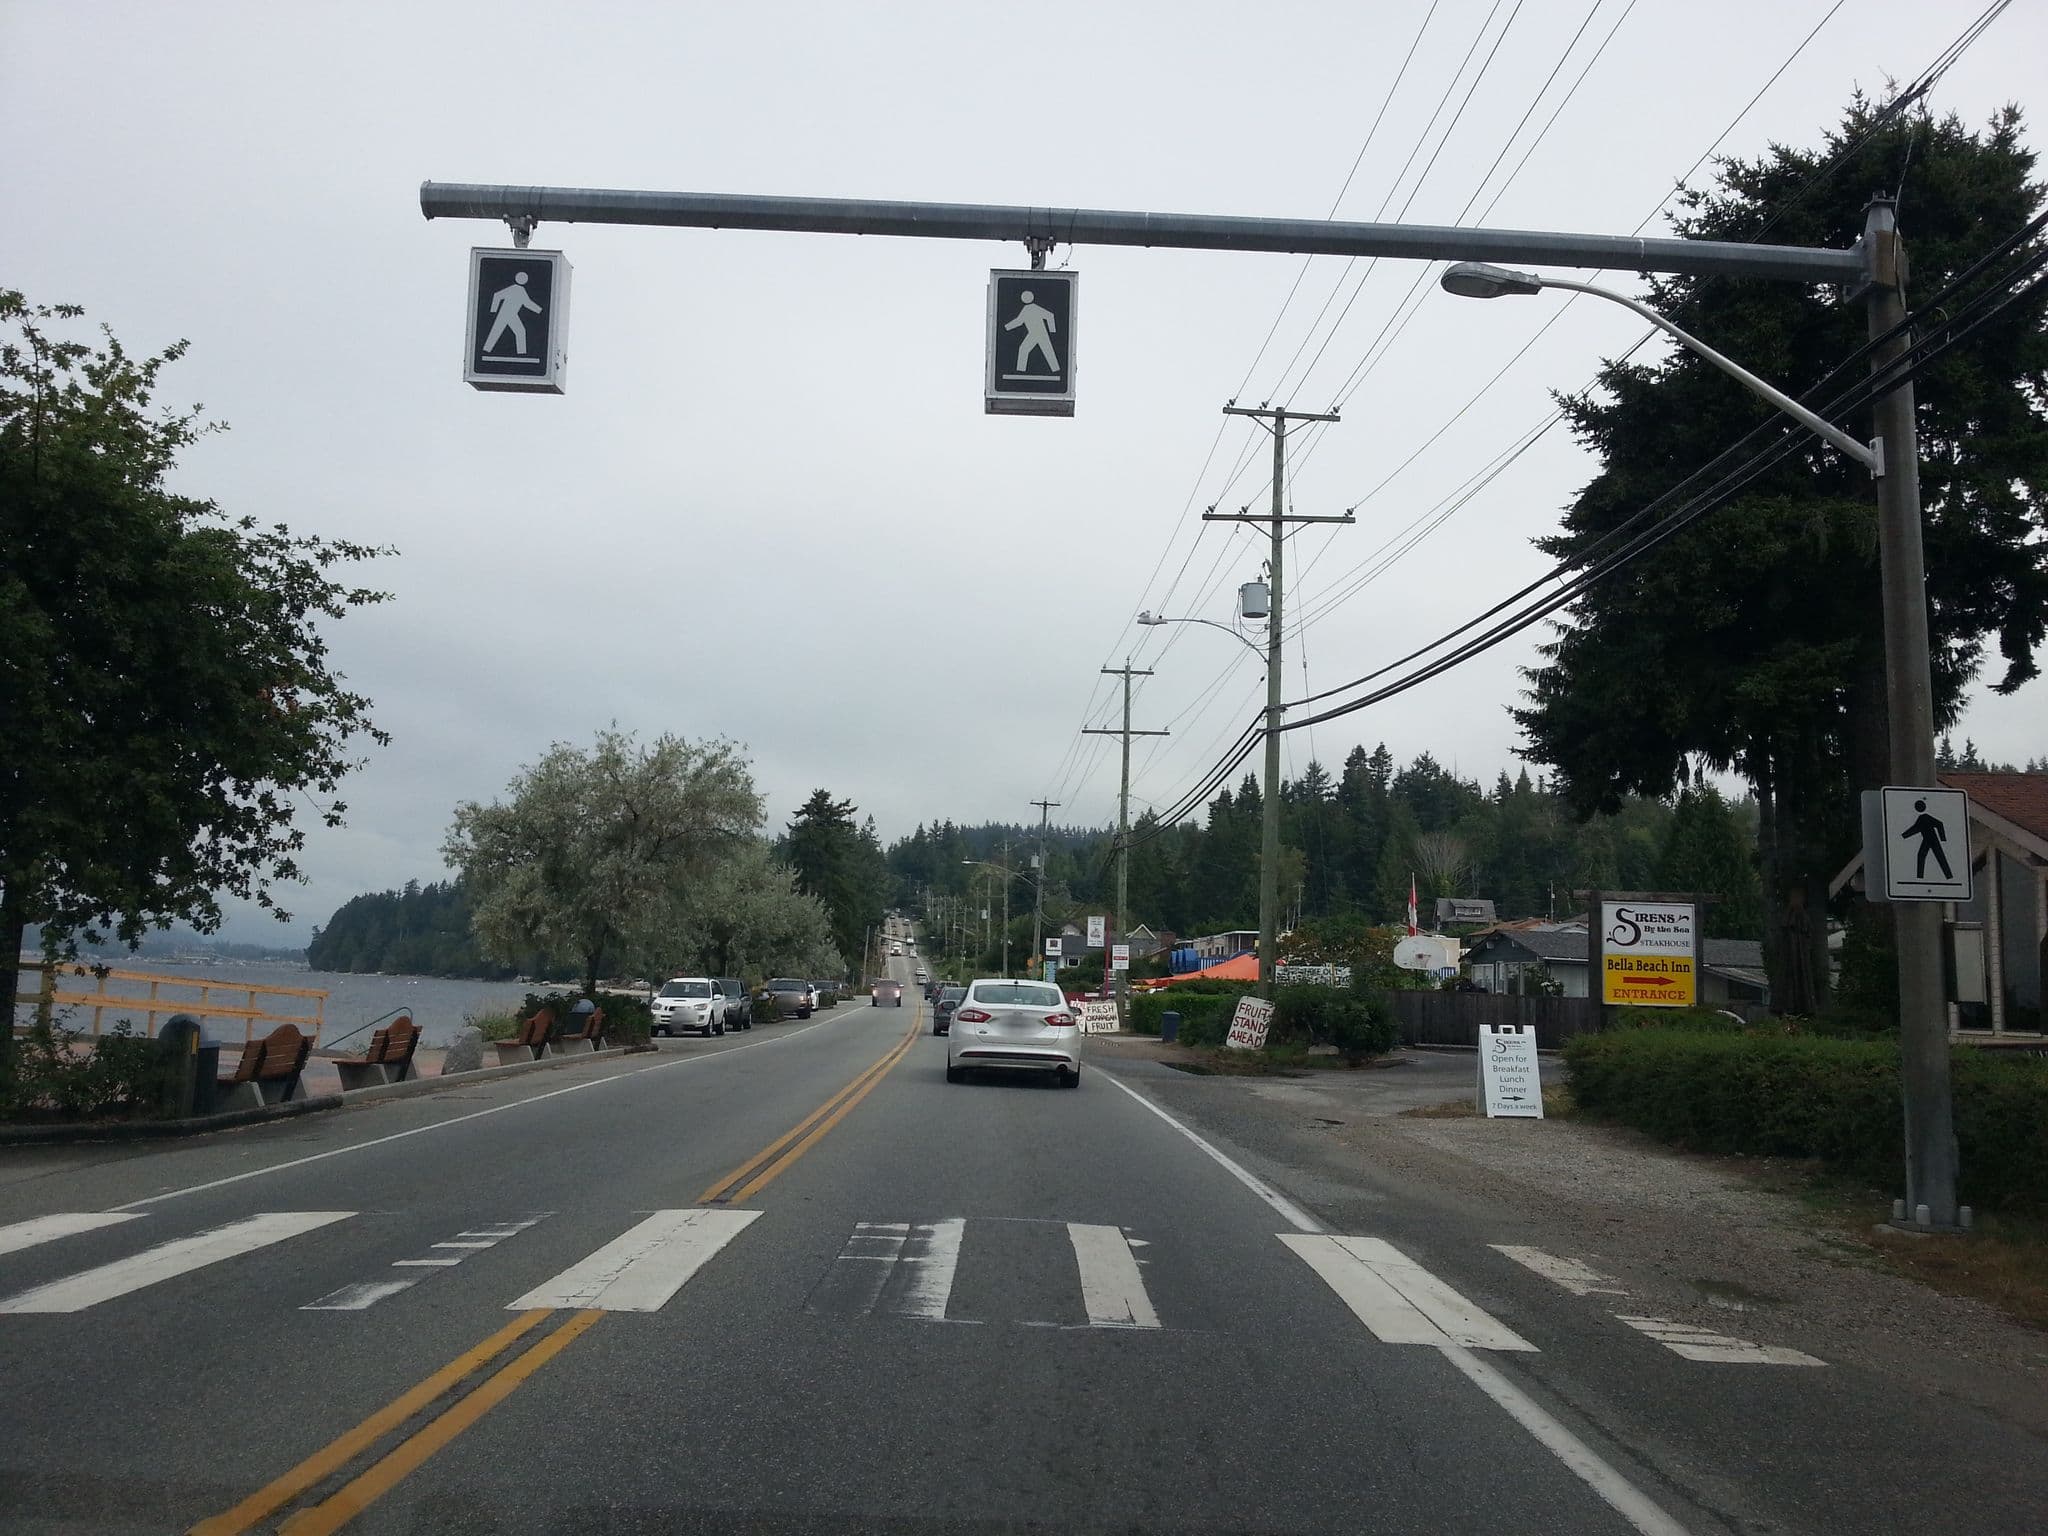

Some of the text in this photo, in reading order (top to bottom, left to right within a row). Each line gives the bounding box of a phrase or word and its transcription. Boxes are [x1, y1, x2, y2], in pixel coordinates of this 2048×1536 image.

[1606, 907, 1675, 946] SIRENS
[1644, 925, 1656, 933] By
[1657, 925, 1671, 933] the
[1640, 939, 1690, 947] STEAKHOUSE
[1607, 958, 1690, 973] Bella Beach Inn
[1613, 988, 1686, 1000] ENTRANCE
[1087, 1004, 1114, 1014] FRESH
[1238, 1002, 1270, 1020] FRUIT
[1091, 1022, 1114, 1031] FRUIT
[1233, 1016, 1266, 1034] STAND
[1228, 1030, 1263, 1048] AHEAD
[1491, 1055, 1527, 1063] Open for
[1492, 1065, 1530, 1073] Breakfast
[1499, 1075, 1525, 1083] Lunch
[1499, 1085, 1527, 1093] Dinner
